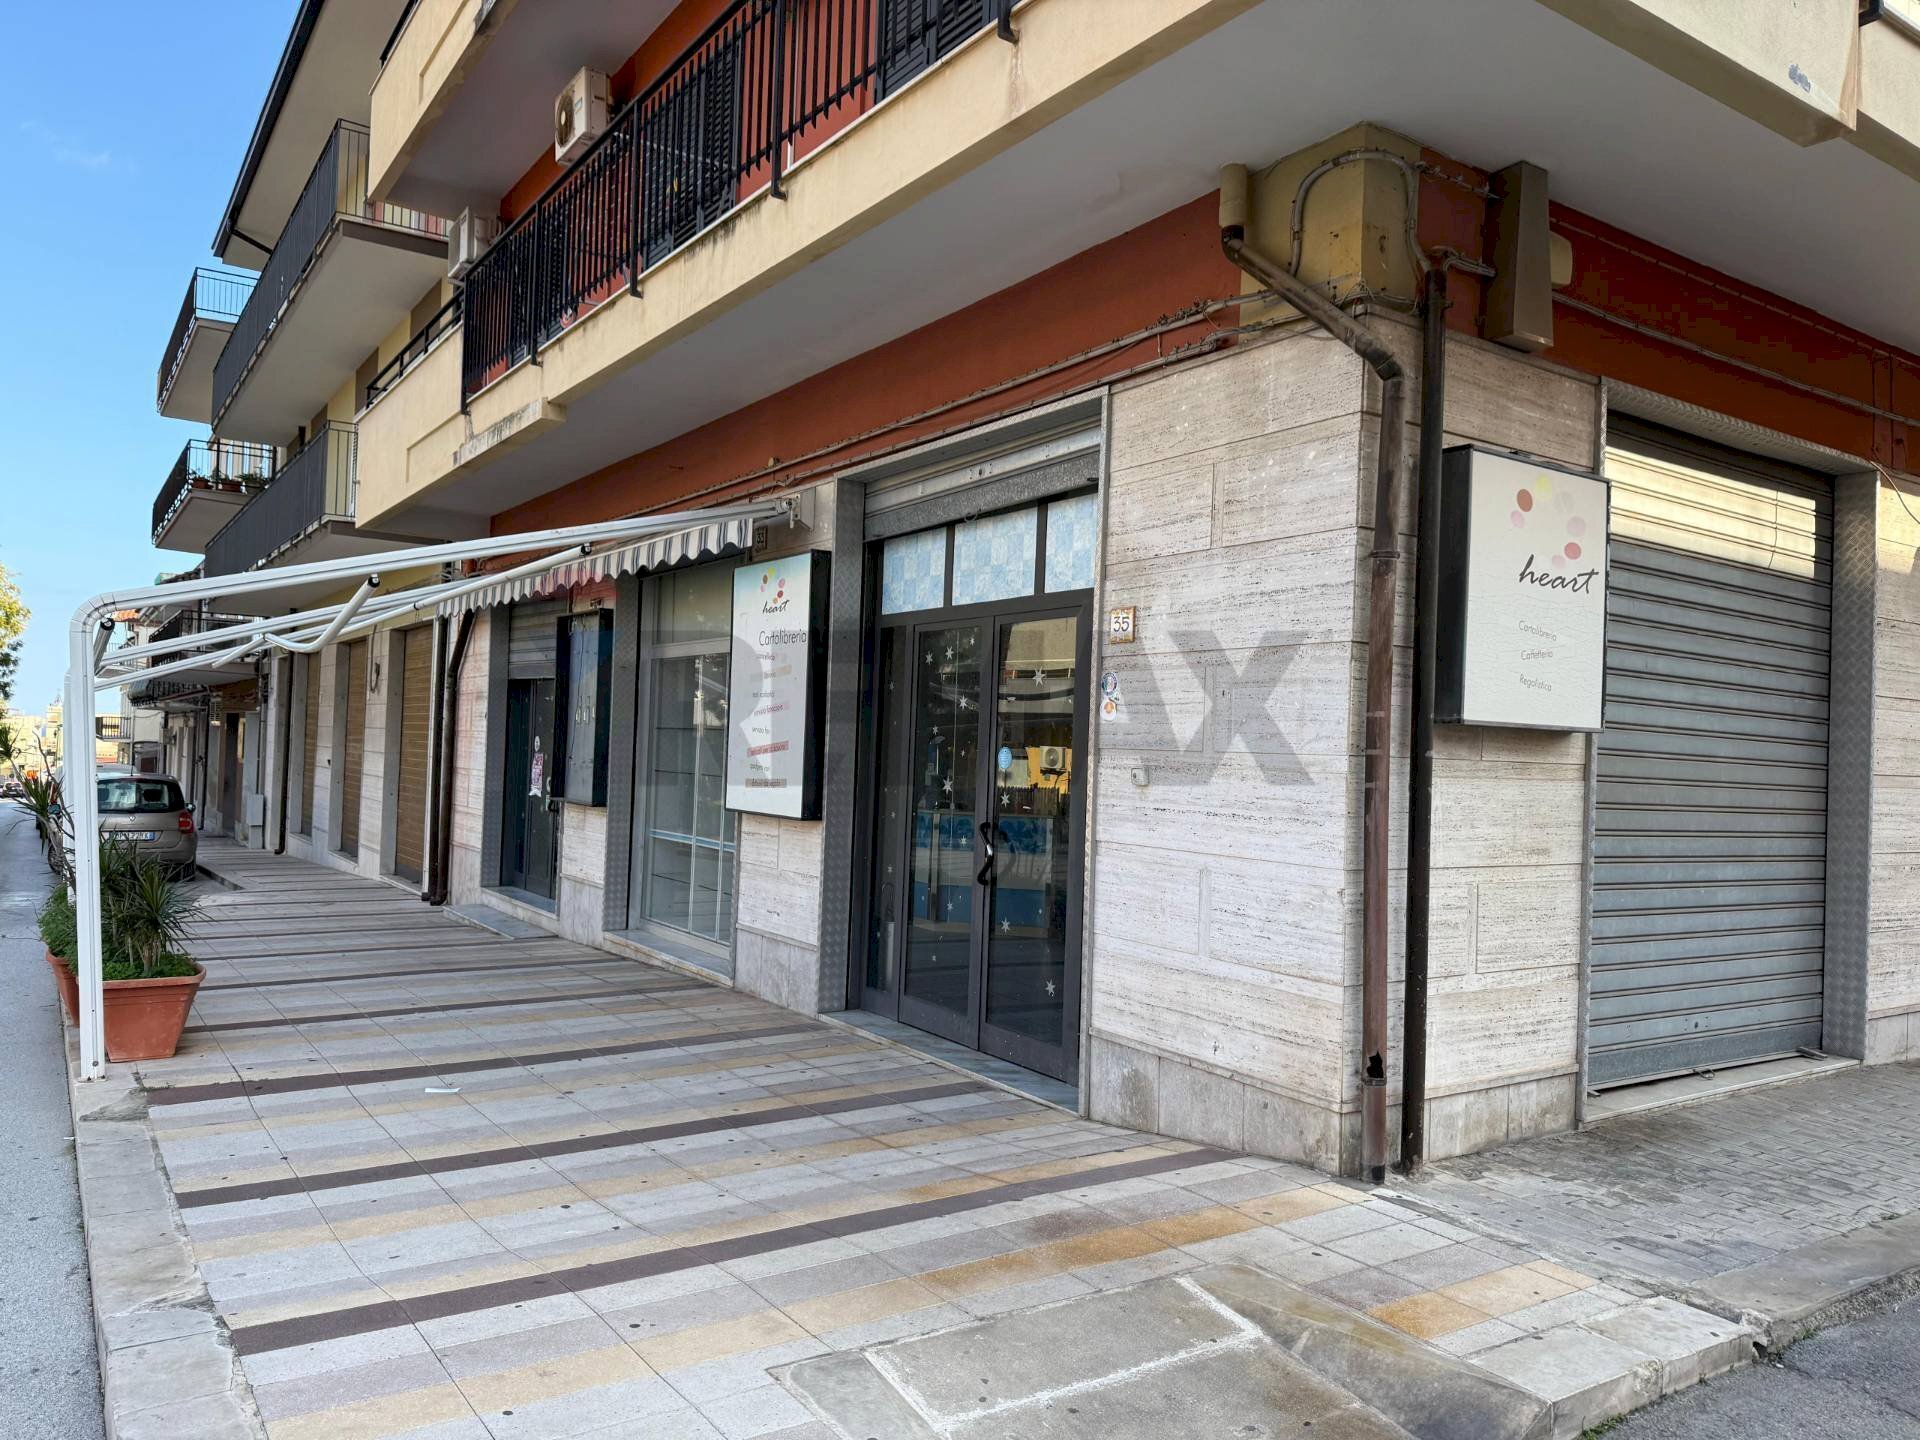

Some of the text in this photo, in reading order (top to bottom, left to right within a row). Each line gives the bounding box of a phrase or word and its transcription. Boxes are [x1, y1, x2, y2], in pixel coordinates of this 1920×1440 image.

[1519, 554, 1599, 594] heart
[762, 600, 790, 614] heart
[1113, 616, 1130, 633] 35
[1518, 620, 1557, 641] Cartolibreria
[759, 628, 807, 647] Cartolibreria
